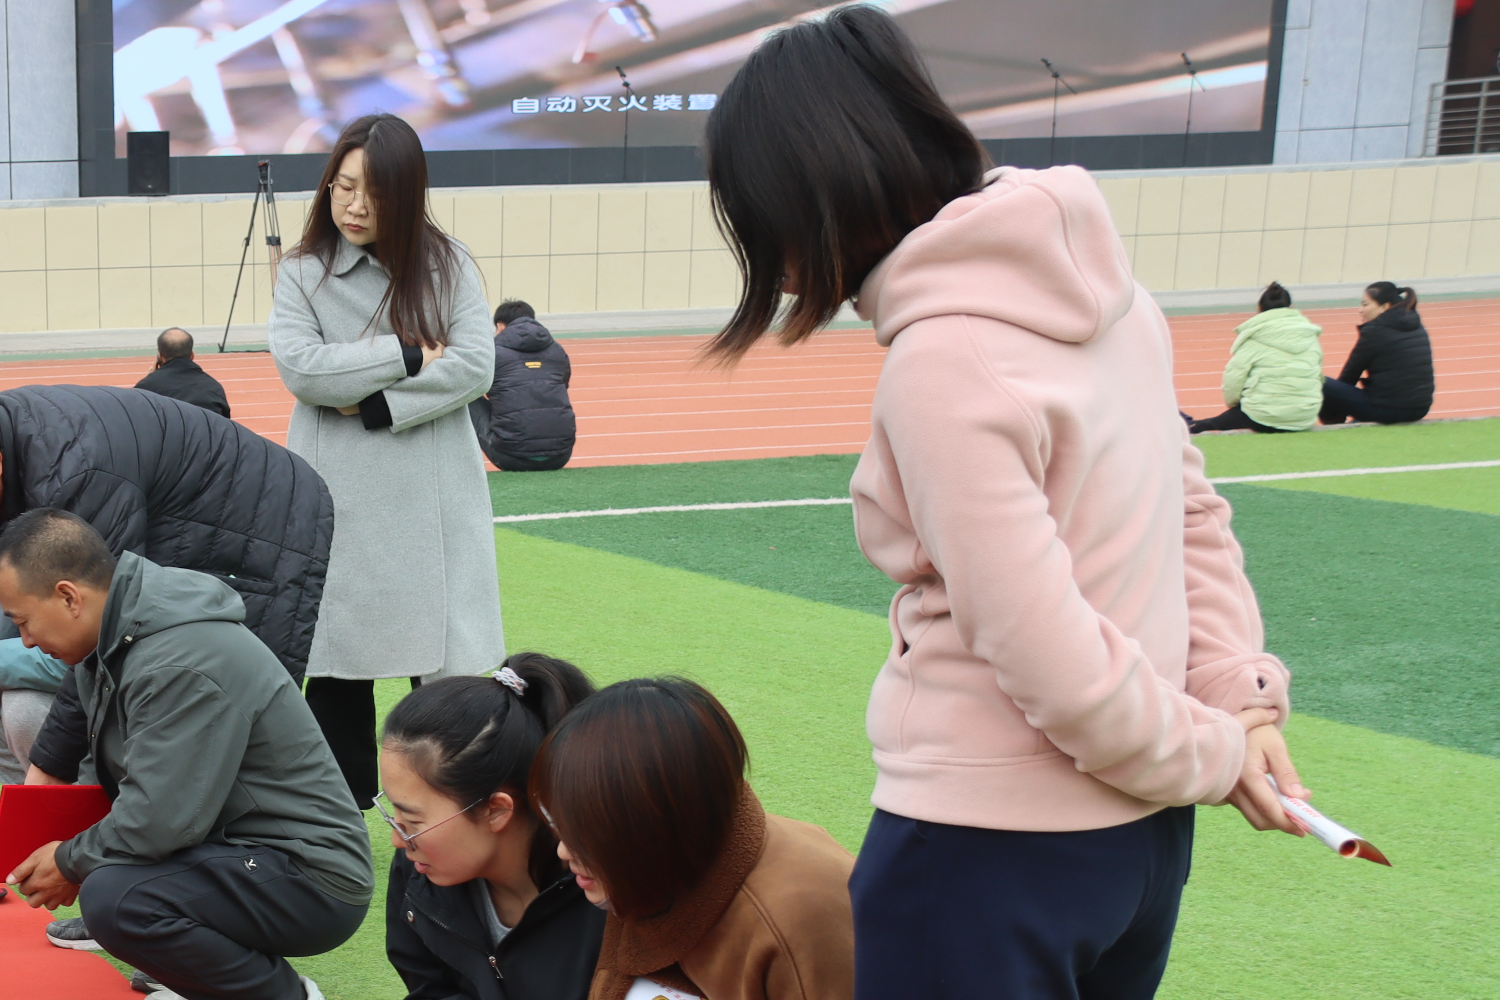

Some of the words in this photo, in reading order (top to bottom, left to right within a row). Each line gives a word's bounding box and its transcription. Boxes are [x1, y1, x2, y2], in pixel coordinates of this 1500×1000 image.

[511, 93, 717, 114] 自动灭火装置
